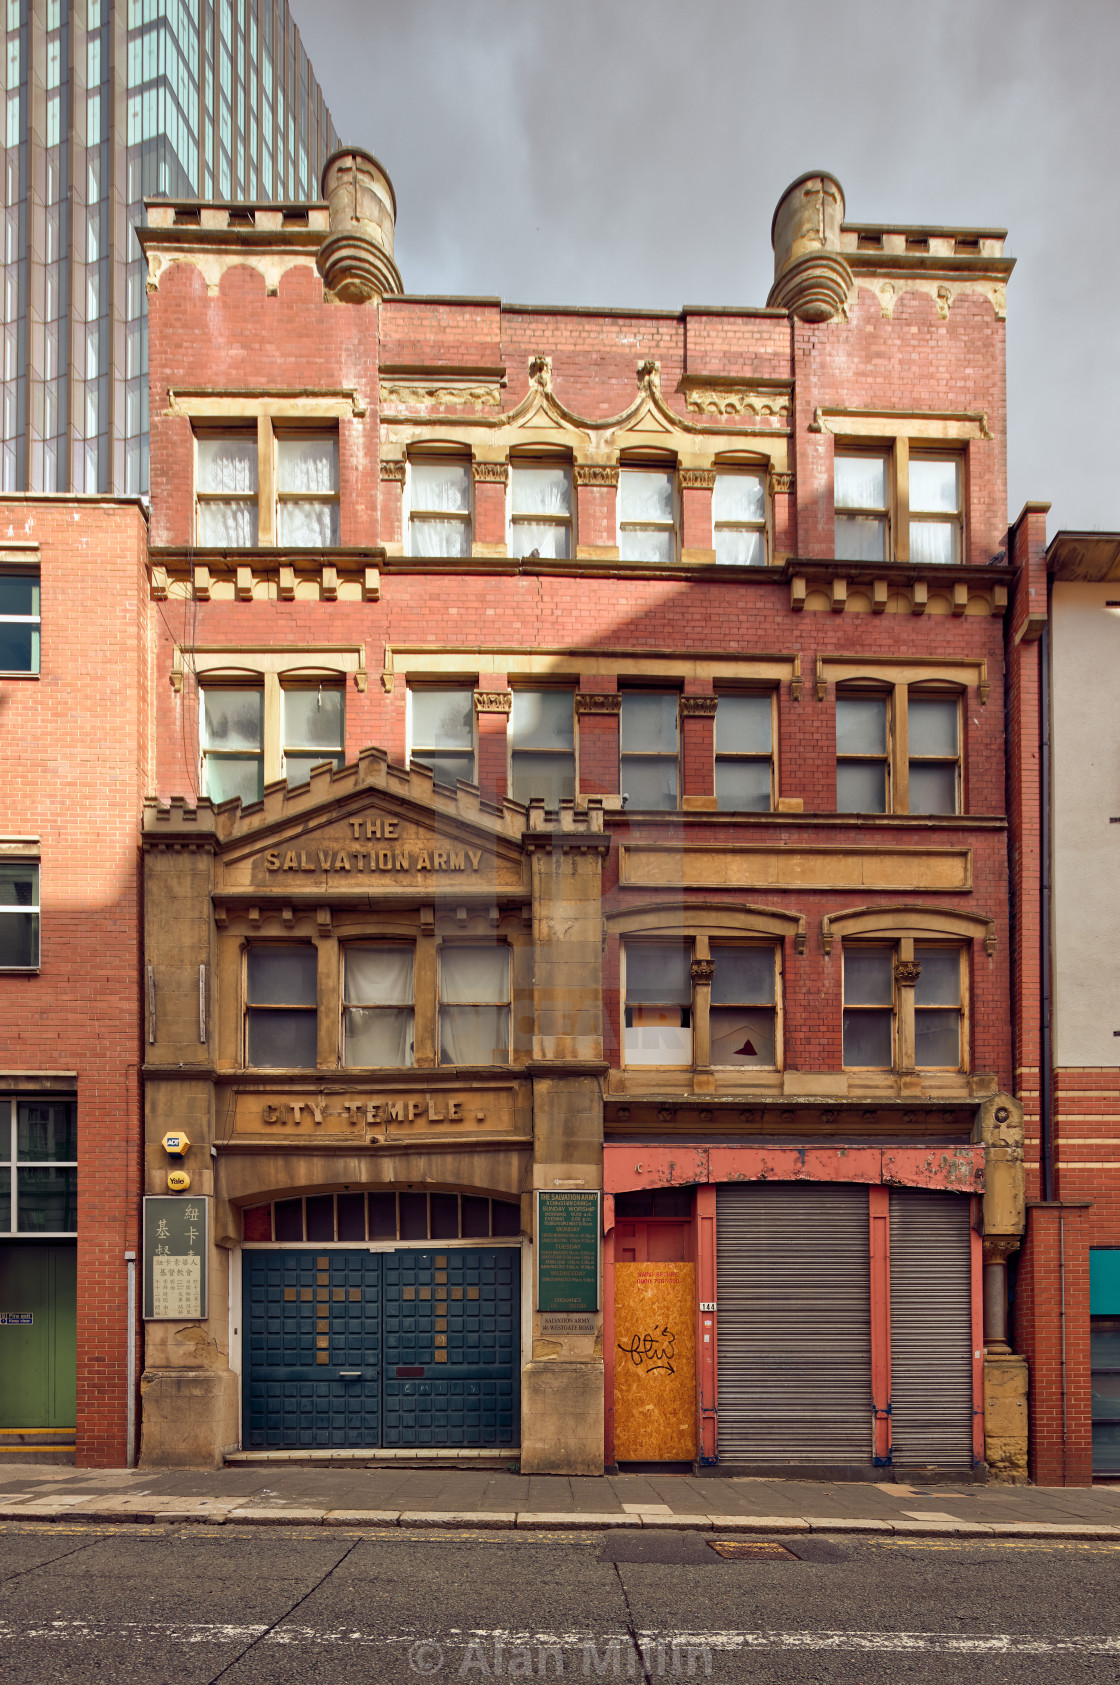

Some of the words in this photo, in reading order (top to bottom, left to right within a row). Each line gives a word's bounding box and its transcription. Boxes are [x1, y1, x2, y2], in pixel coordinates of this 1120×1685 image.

[349, 818, 399, 840] THE
[265, 849, 411, 873] SALVATION
[416, 848, 483, 872] ARMY
[262, 1101, 328, 1125] CITY
